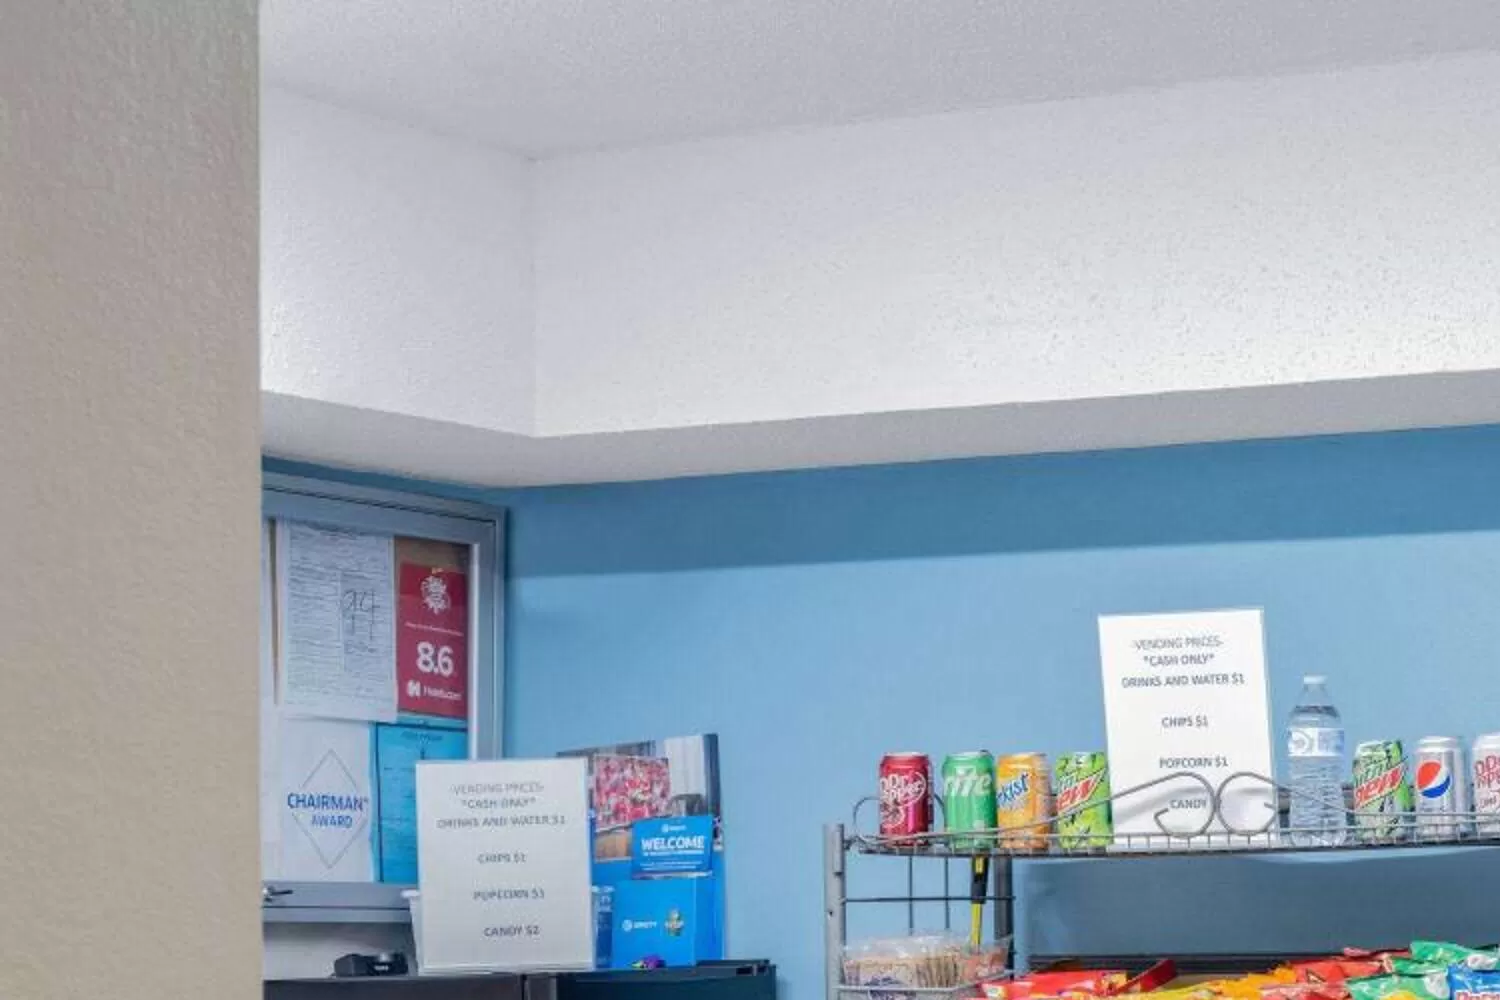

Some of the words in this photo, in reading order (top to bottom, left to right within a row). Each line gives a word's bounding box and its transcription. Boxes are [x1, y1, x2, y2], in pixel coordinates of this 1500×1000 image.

[416, 641, 454, 678] 8.6
[1121, 676, 1162, 689] DRINKS
[1164, 675, 1188, 687] AND
[1191, 673, 1229, 686] WATER
[1232, 672, 1245, 685] $1
[1161, 717, 1193, 728] CHIPS
[1195, 716, 1208, 729] $1
[1159, 757, 1213, 769] POPCORN
[1215, 757, 1228, 768] $1
[1170, 799, 1207, 810] CANDY
[311, 814, 353, 829] AWARD
[482, 816, 508, 828] AND
[512, 815, 549, 828] WATER
[641, 836, 705, 851] WELCOME
[483, 925, 523, 937] CANDY
